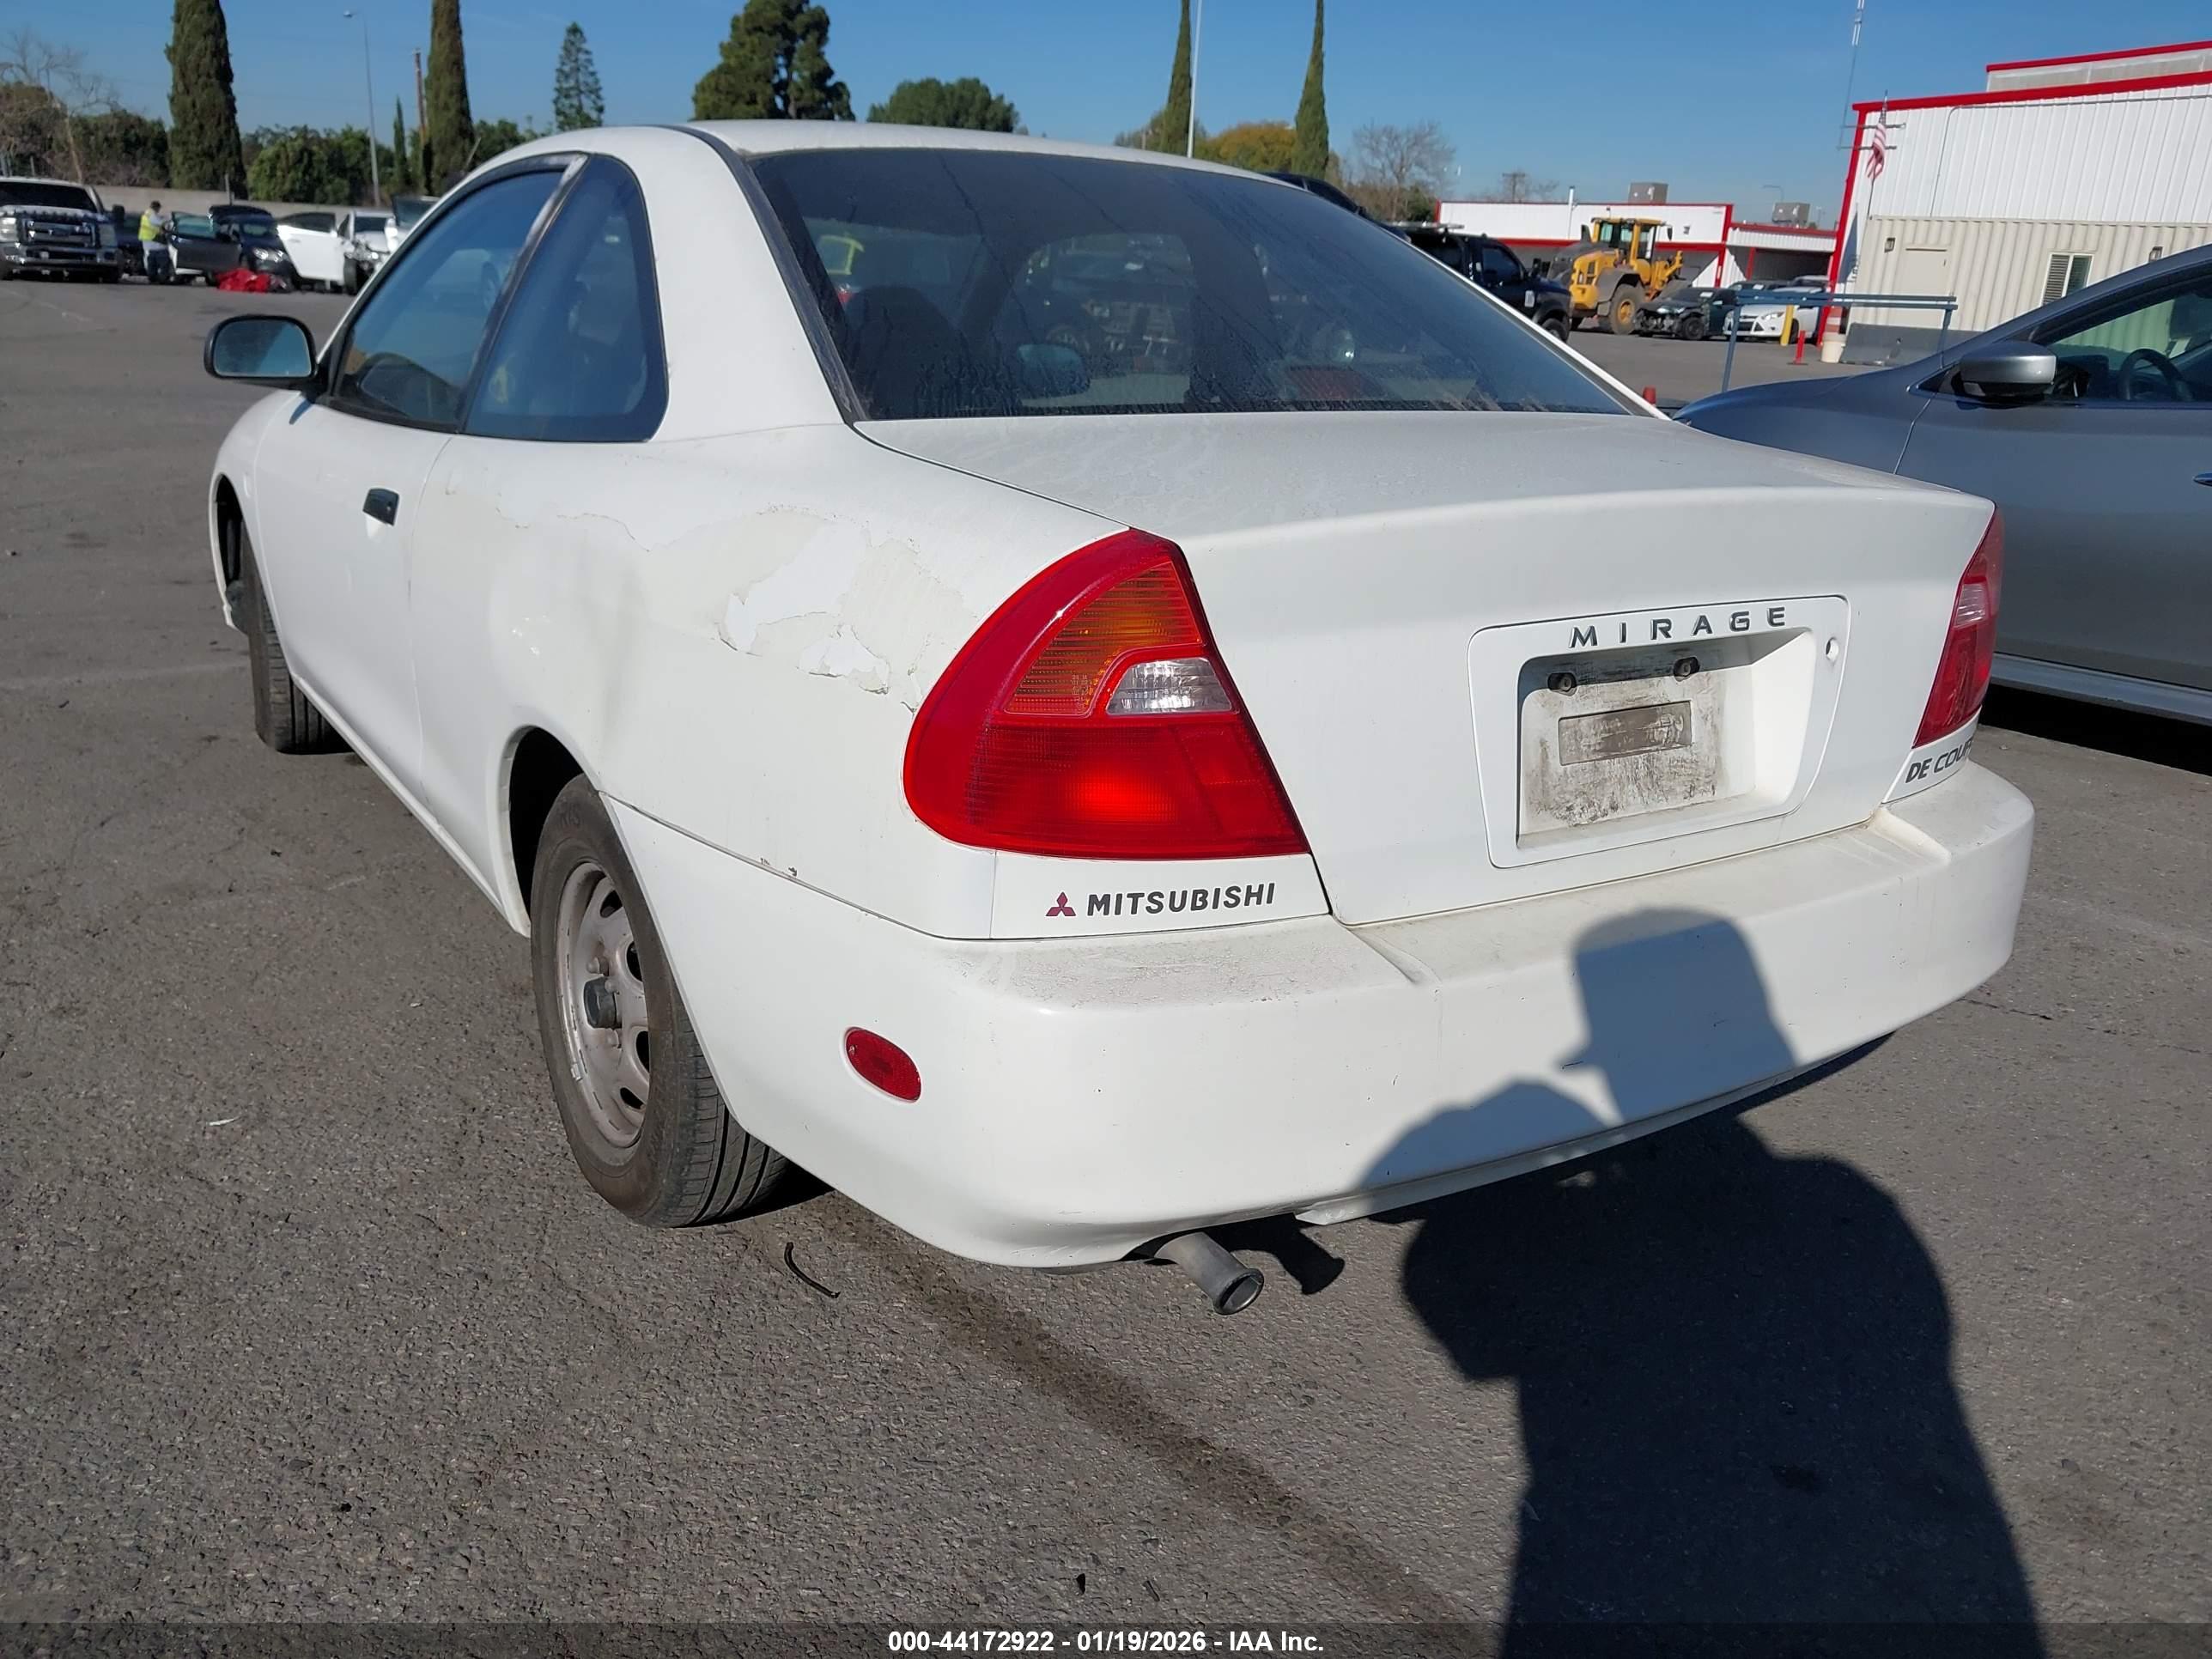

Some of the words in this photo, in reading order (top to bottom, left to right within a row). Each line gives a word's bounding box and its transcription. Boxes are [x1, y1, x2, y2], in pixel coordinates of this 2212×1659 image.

[1569, 606, 1785, 649] MIRAGE
[1905, 757, 1933, 784] DE
[1087, 882, 1275, 916] MITSUBISHI
